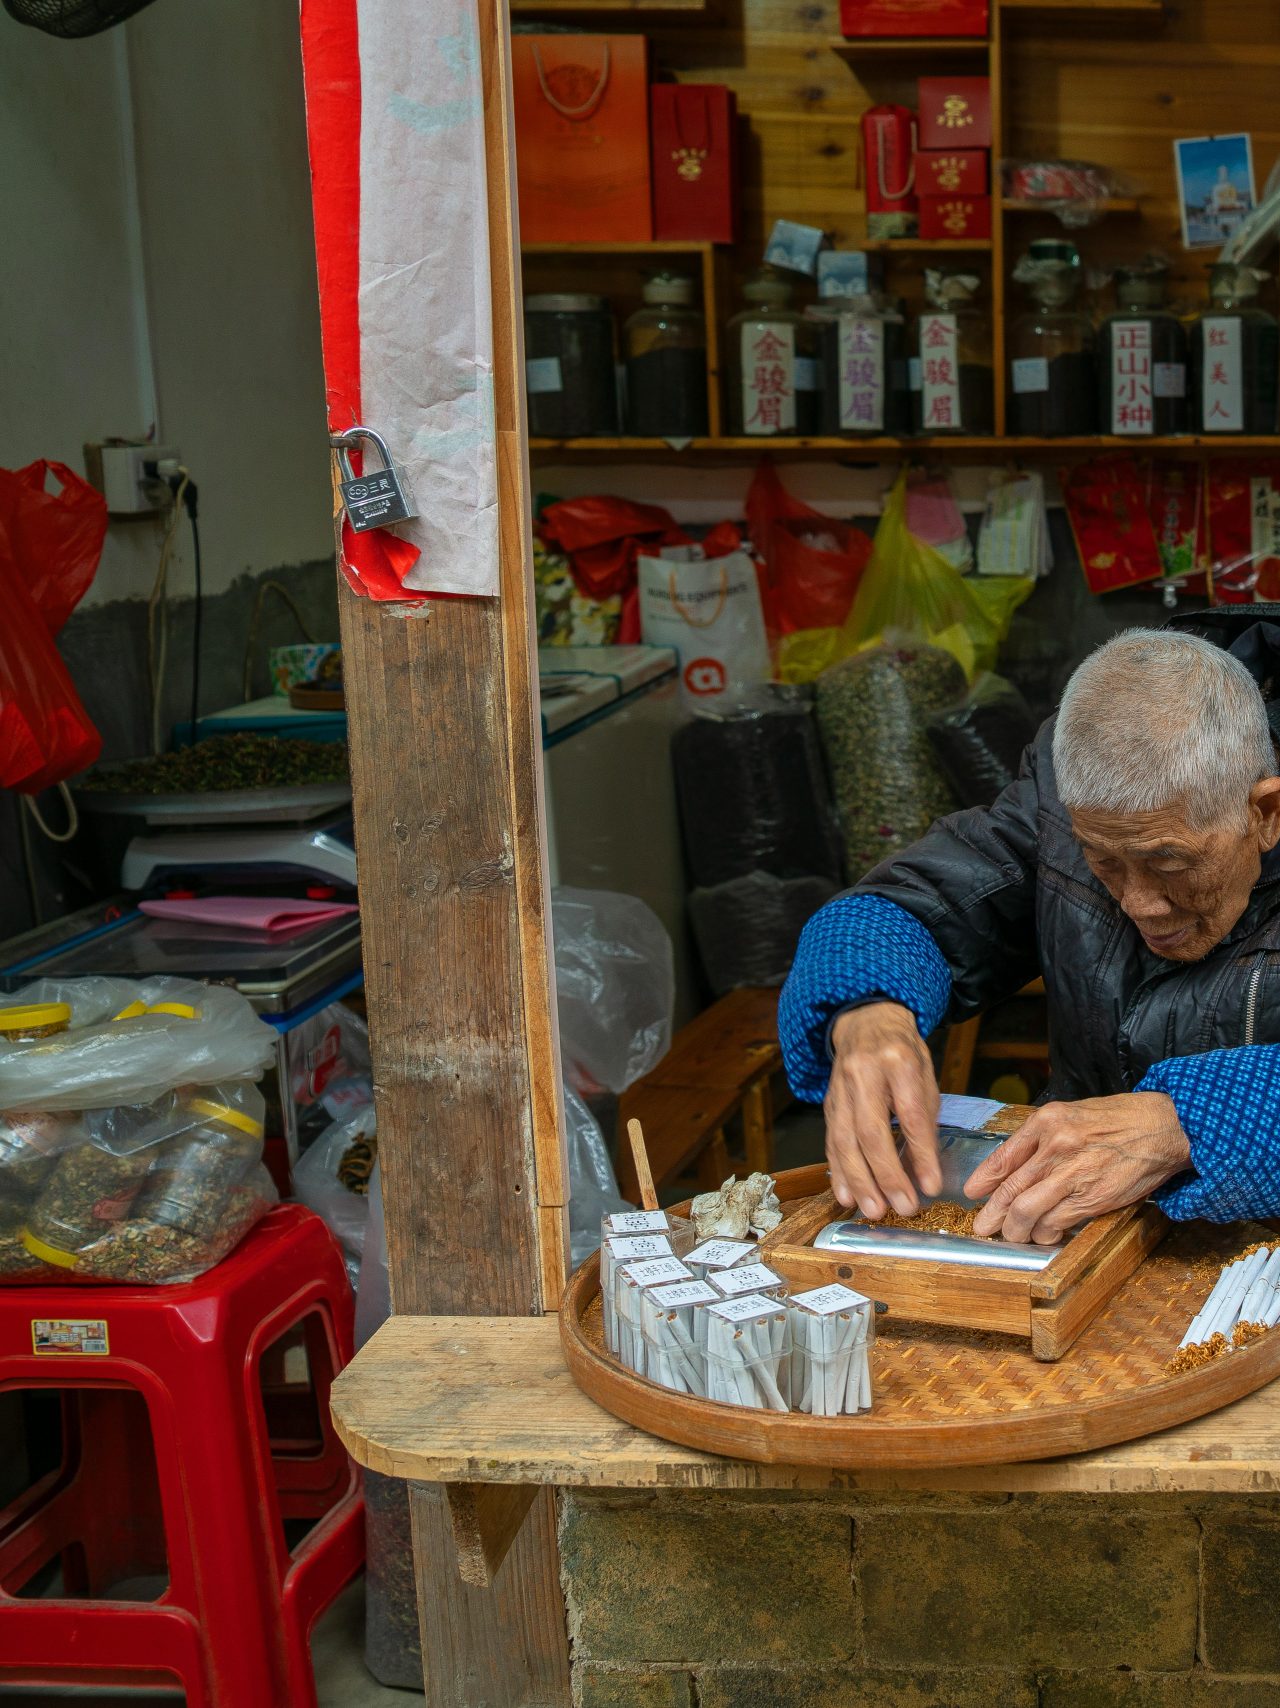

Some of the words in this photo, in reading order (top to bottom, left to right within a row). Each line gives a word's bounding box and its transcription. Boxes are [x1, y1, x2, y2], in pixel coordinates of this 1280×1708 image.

[746, 330, 790, 430] 金骏眉
[843, 322, 880, 422] 金骏眉
[922, 318, 957, 428] 金骏眉
[1117, 326, 1152, 428] 正山小种
[1208, 326, 1230, 419] 红美人
